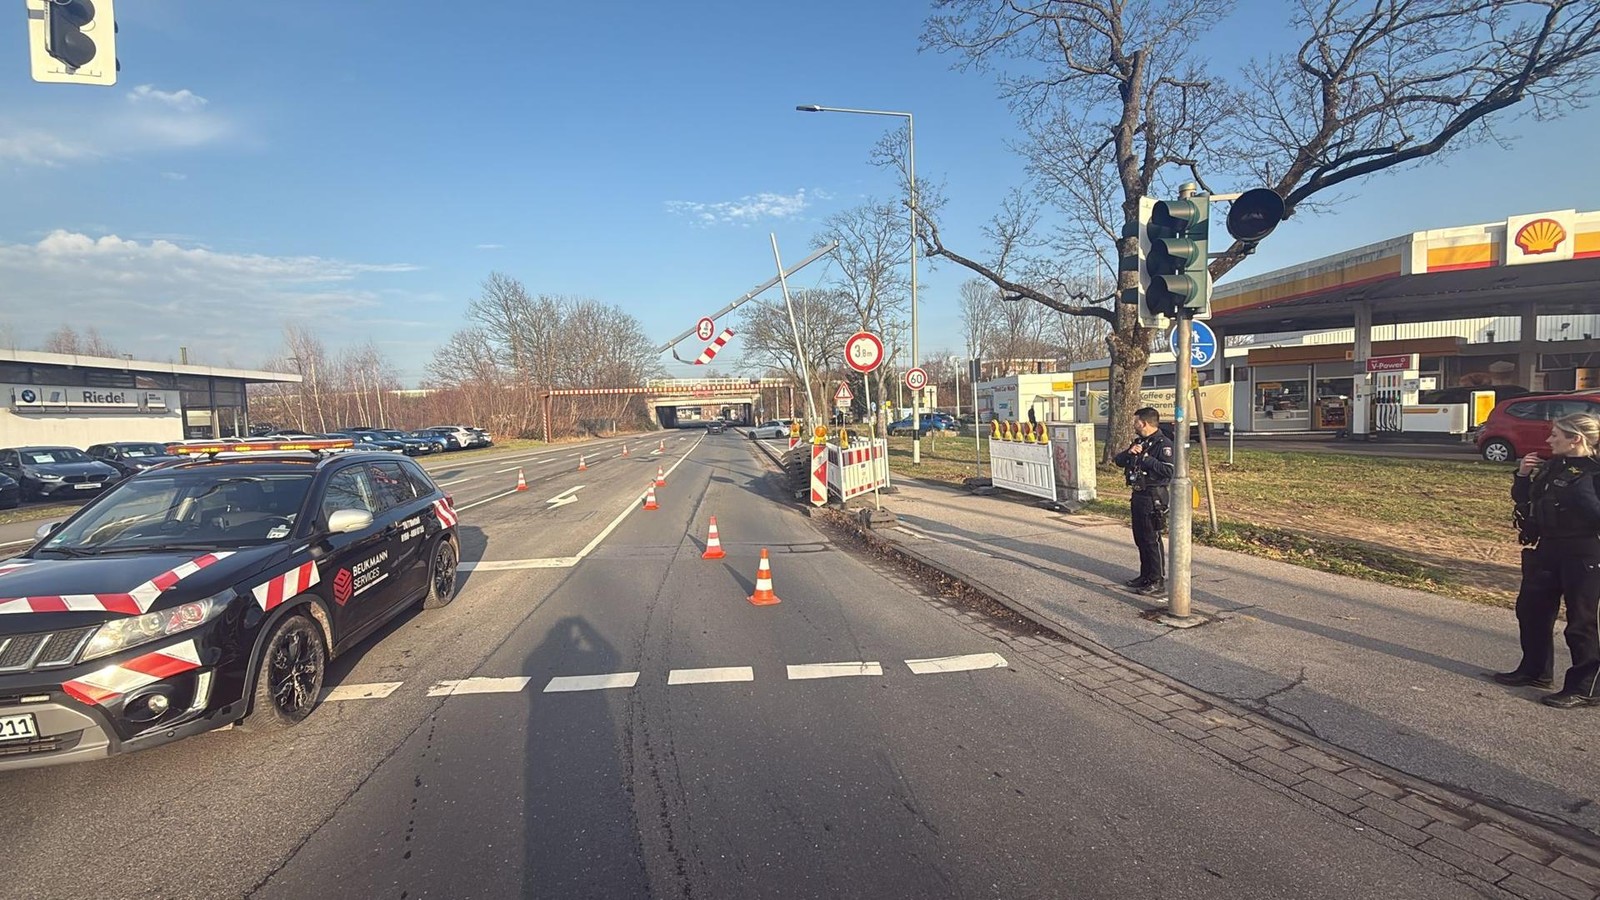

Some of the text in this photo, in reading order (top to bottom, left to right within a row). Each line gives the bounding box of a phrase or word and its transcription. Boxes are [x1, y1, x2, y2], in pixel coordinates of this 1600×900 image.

[911, 374, 922, 384] 60
[82, 391, 125, 404] Riedel
[352, 550, 388, 576] BEUKMANN
[353, 567, 380, 590] SERVICES
